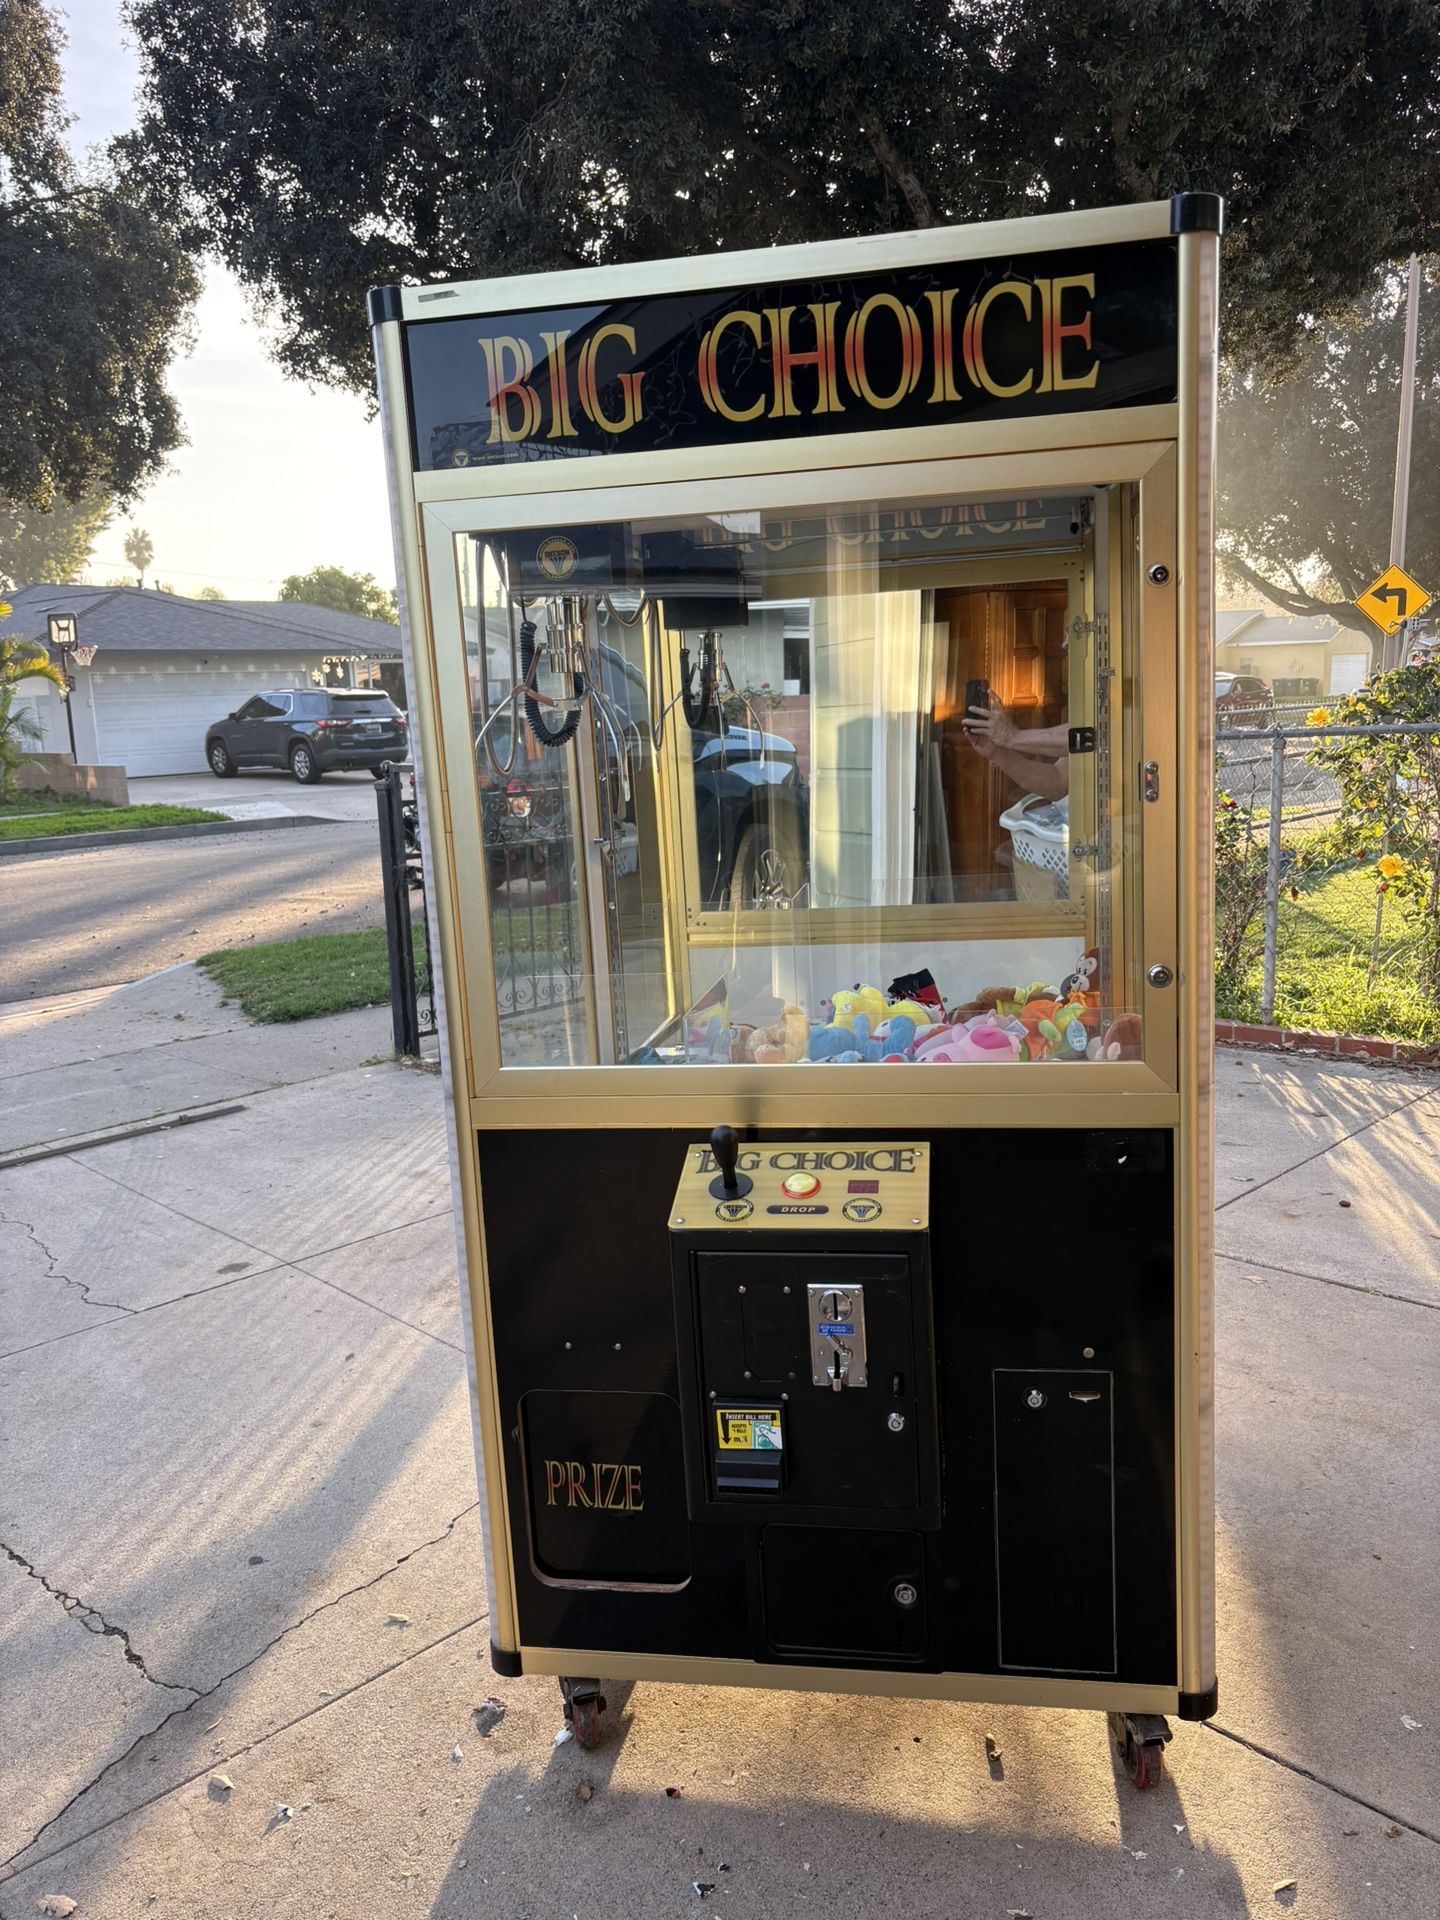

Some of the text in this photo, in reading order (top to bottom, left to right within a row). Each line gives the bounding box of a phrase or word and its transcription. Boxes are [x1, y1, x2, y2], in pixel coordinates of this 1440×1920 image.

[477, 272, 1101, 445] BIG CHOICE
[696, 1148, 917, 1174] BG CHOICE
[780, 1205, 817, 1214] DROP
[725, 1412, 745, 1421] INSERT
[544, 1459, 645, 1511] PRIZE
